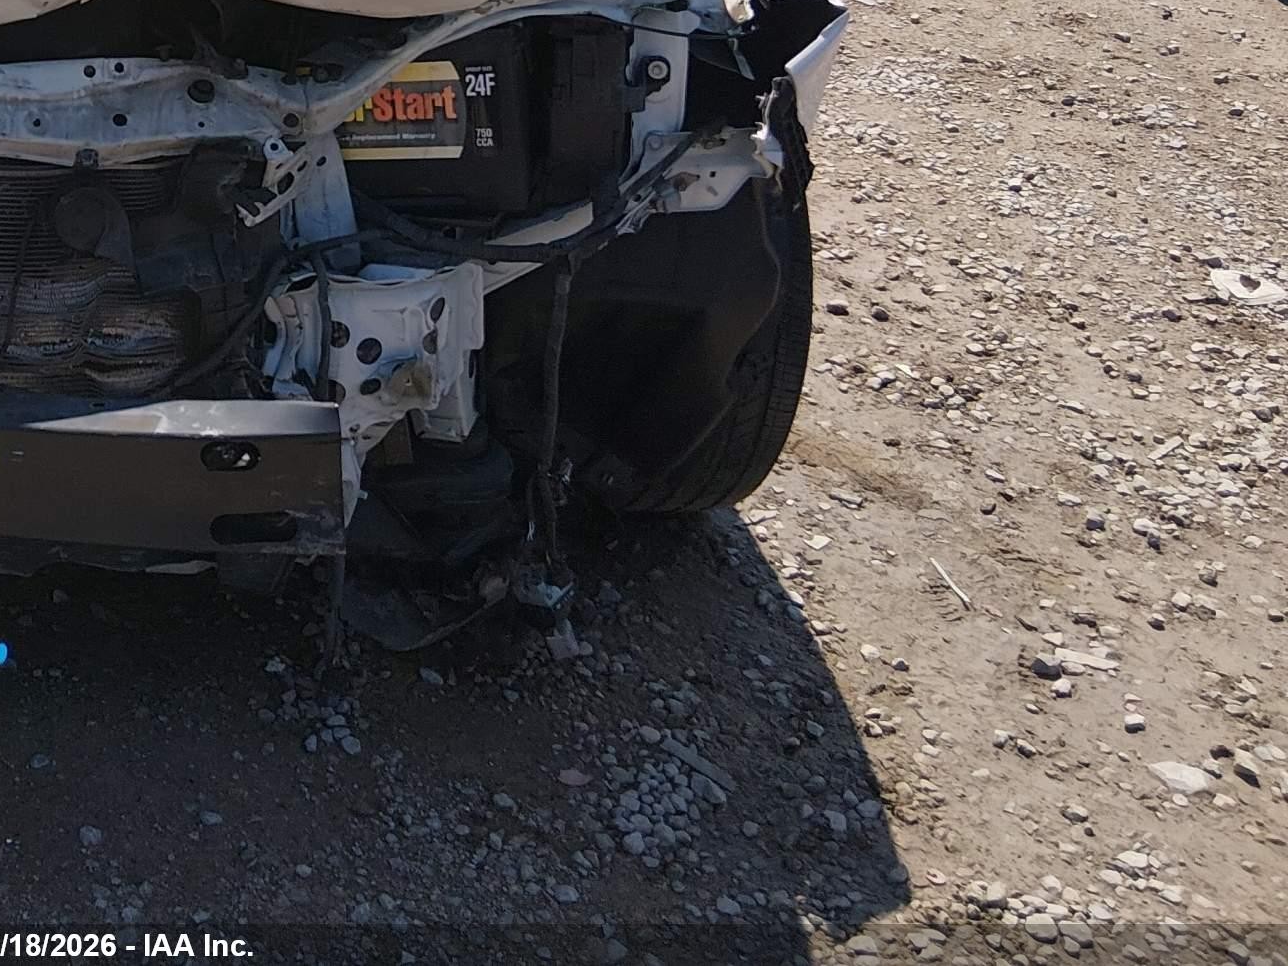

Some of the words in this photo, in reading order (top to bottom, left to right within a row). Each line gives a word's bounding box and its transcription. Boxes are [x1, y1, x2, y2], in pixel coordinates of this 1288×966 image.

[464, 72, 497, 97] 24F
[475, 127, 493, 138] 750
[475, 137, 494, 147] CCA
